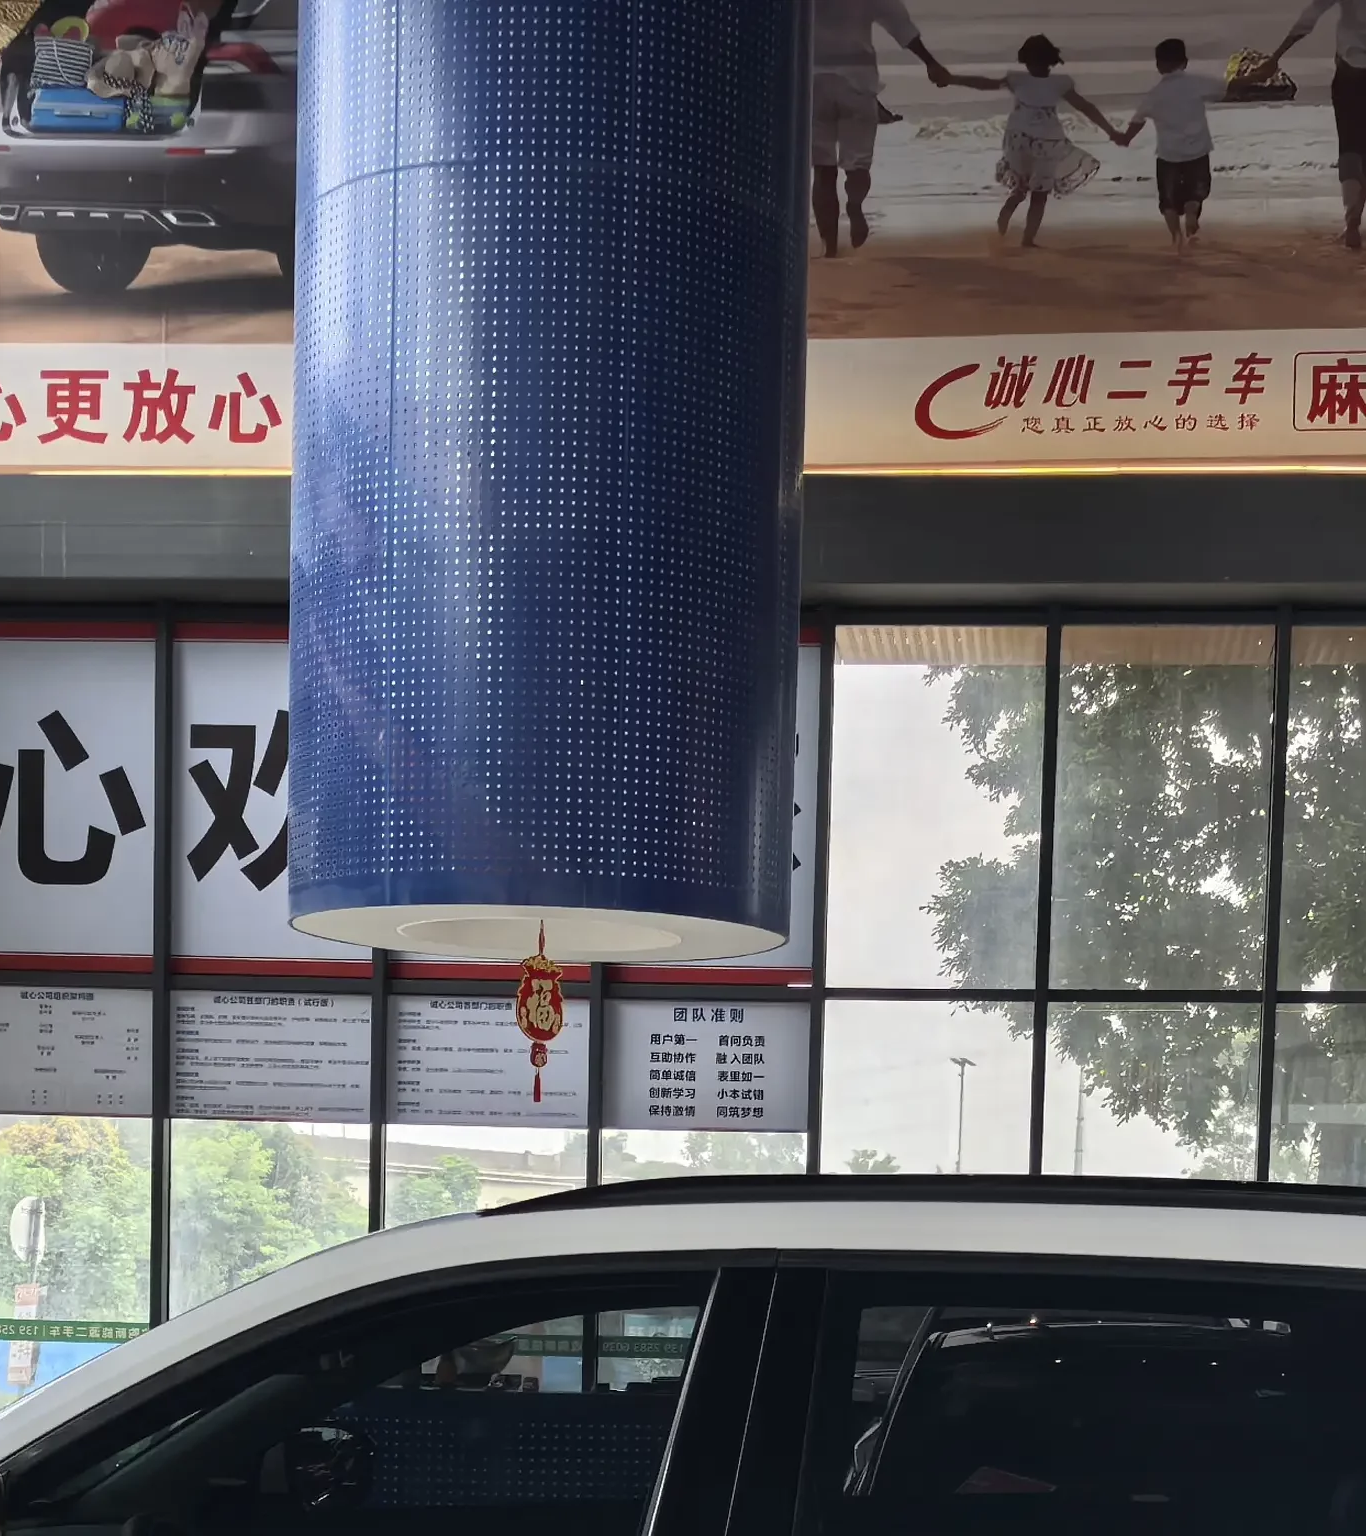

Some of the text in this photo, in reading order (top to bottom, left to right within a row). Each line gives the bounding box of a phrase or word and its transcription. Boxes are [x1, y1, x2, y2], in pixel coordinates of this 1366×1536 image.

[983, 352, 1273, 410] 诚心二手车
[1019, 411, 1261, 436] 您真正放心的选择
[527, 979, 555, 1031] 福
[673, 1007, 745, 1023] 团队准则
[649, 1034, 698, 1046] 用户第一
[718, 1035, 766, 1047] 首问负责
[649, 1052, 697, 1064] 互助协作
[649, 1070, 697, 1082] 简单诚信
[717, 1071, 765, 1082] 表里如一
[648, 1087, 697, 1099] 创新学习
[648, 1105, 697, 1117] 保持激情
[716, 1106, 764, 1119] 同筑梦想
